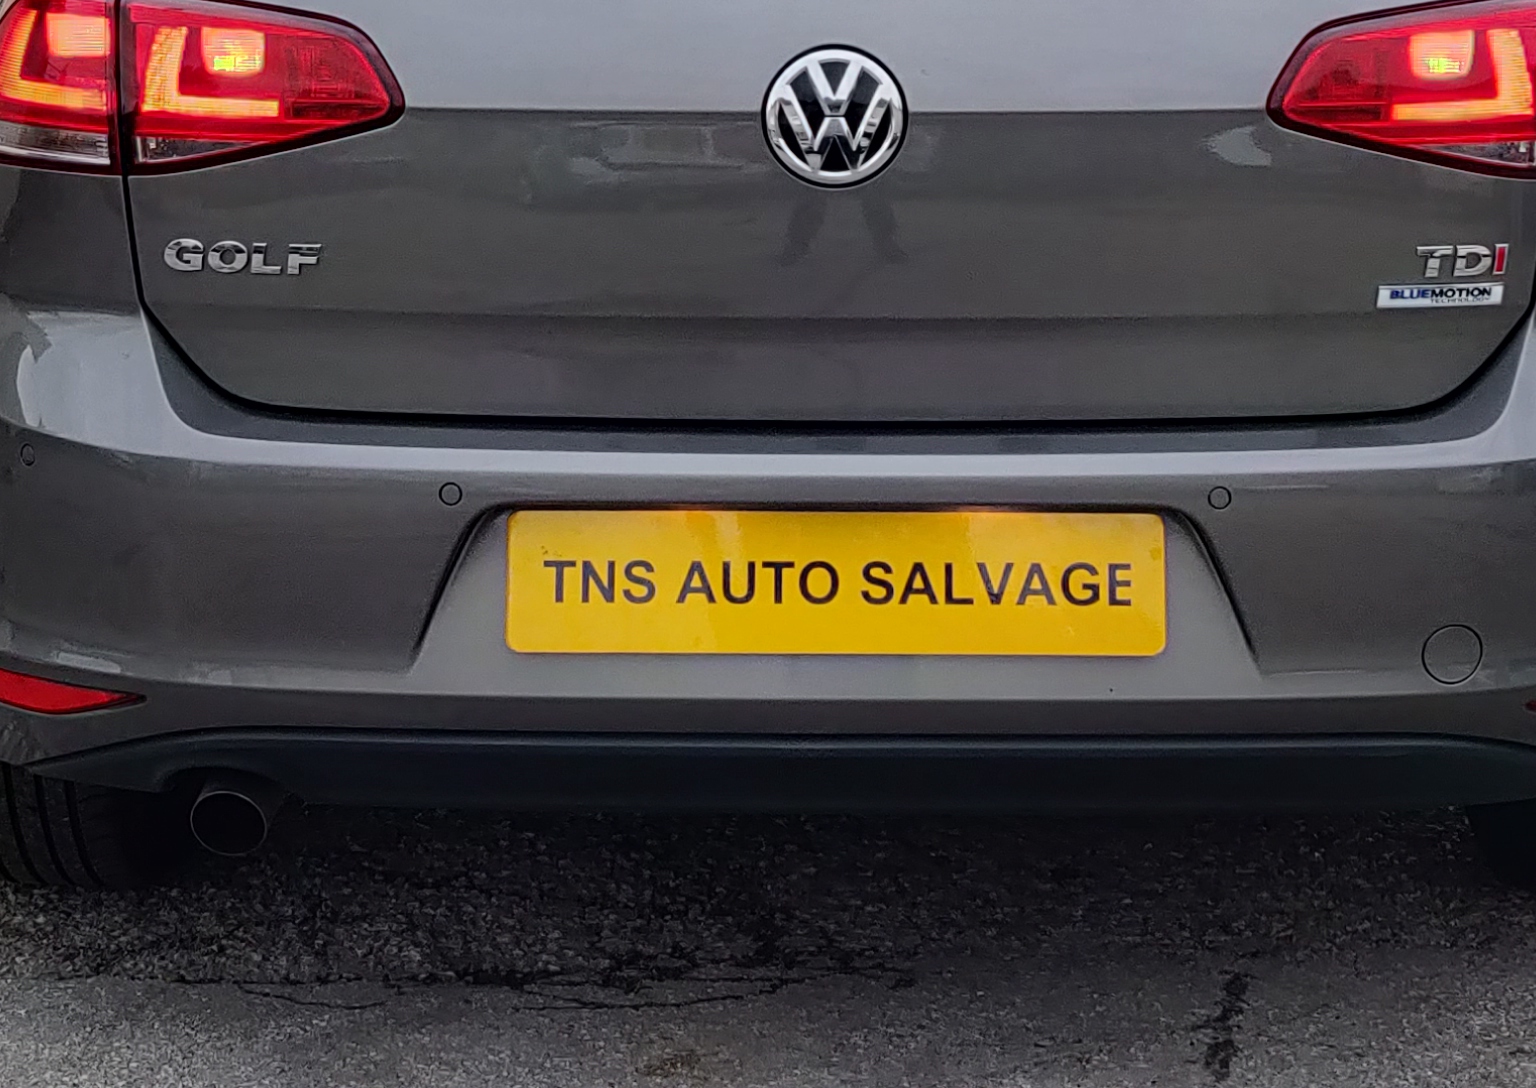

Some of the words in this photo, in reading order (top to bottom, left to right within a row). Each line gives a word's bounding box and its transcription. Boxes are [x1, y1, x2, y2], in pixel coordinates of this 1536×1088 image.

[163, 238, 322, 275] GOLF
[1416, 243, 1510, 278] TDI
[1390, 287, 1492, 300] BLUEMOTION
[543, 559, 656, 604] TNS
[676, 560, 840, 605] AUTO
[860, 560, 1133, 606] SALVAGE
